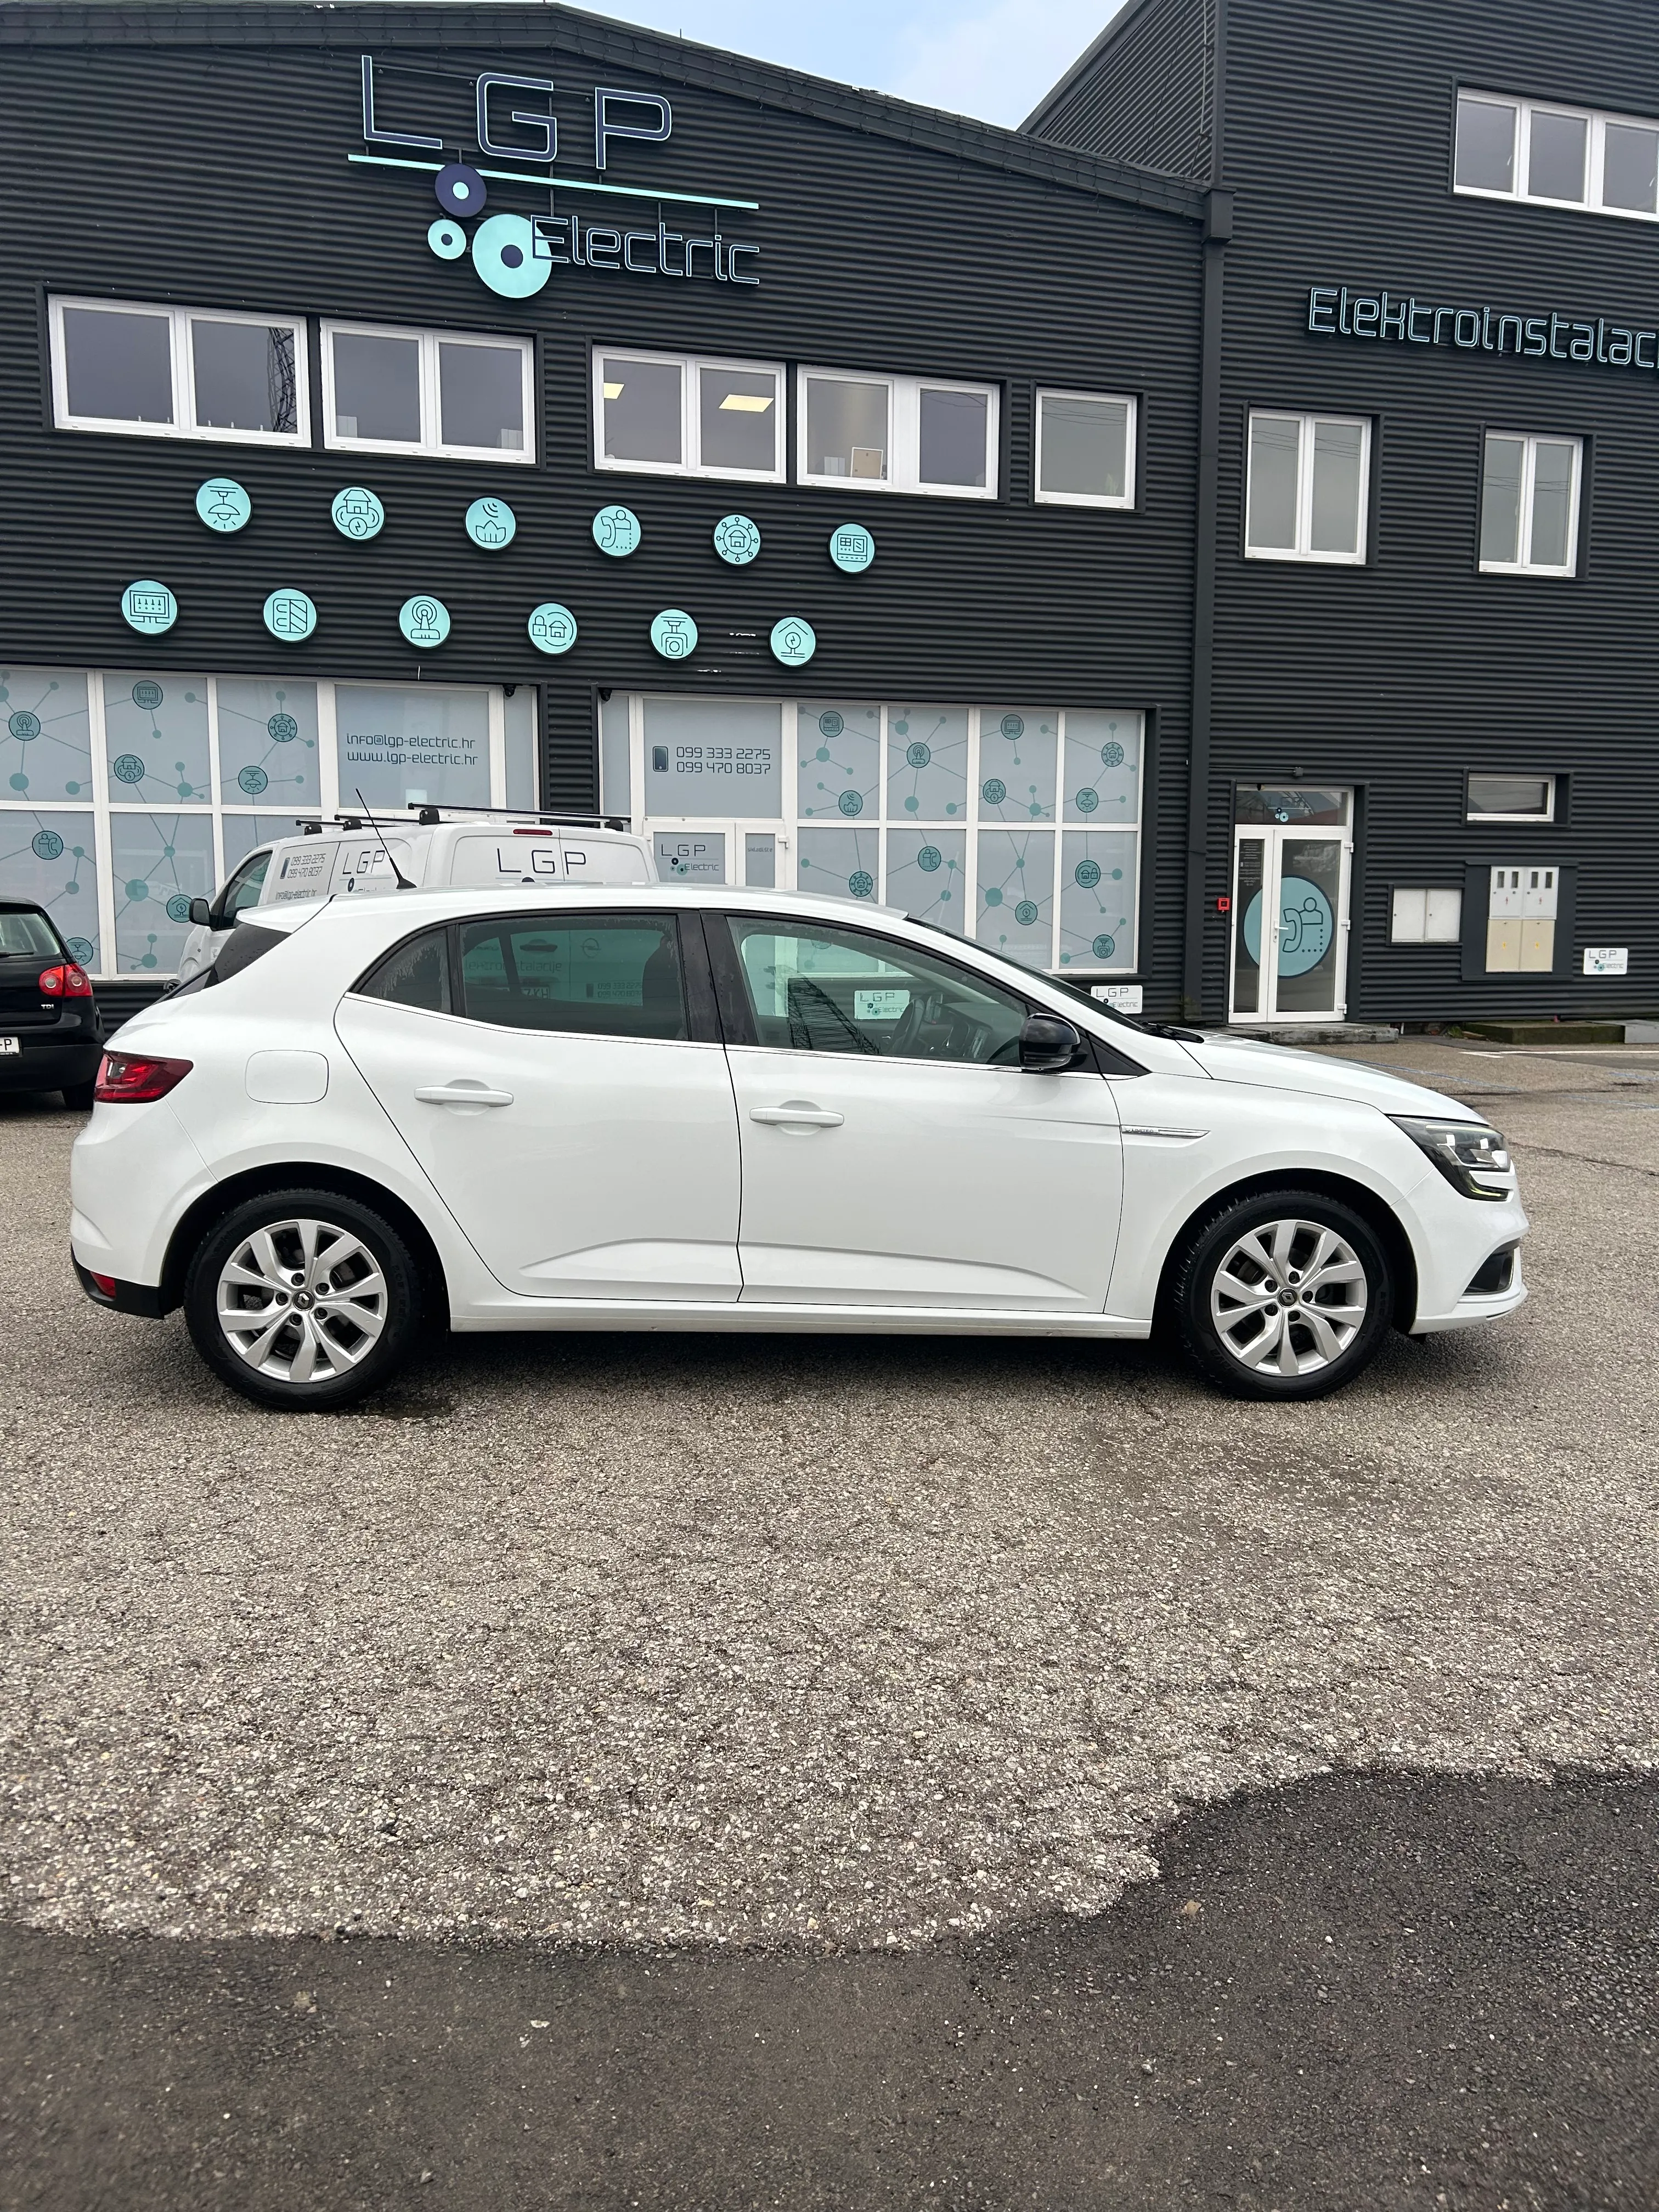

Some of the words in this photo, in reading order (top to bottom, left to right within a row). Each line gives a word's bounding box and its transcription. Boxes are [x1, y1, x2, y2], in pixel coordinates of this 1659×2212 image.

[361, 55, 672, 170] LGP
[530, 215, 760, 285] Electric
[1308, 286, 1659, 368] Elektroinstalac
[347, 751, 478, 765] www.lgp-electric.hr
[676, 747, 702, 758] 099
[706, 747, 732, 759] 333
[736, 748, 770, 760] 2275
[676, 761, 702, 773] 099
[706, 762, 732, 774] 470
[736, 763, 770, 774] 8037
[661, 844, 706, 856] LGP
[342, 850, 385, 874] LGP
[497, 848, 586, 875] LGP
[685, 863, 719, 871] Electric
[1589, 950, 1617, 958] LGP
[860, 992, 895, 1002] LGP
[1096, 988, 1128, 997] LGP
